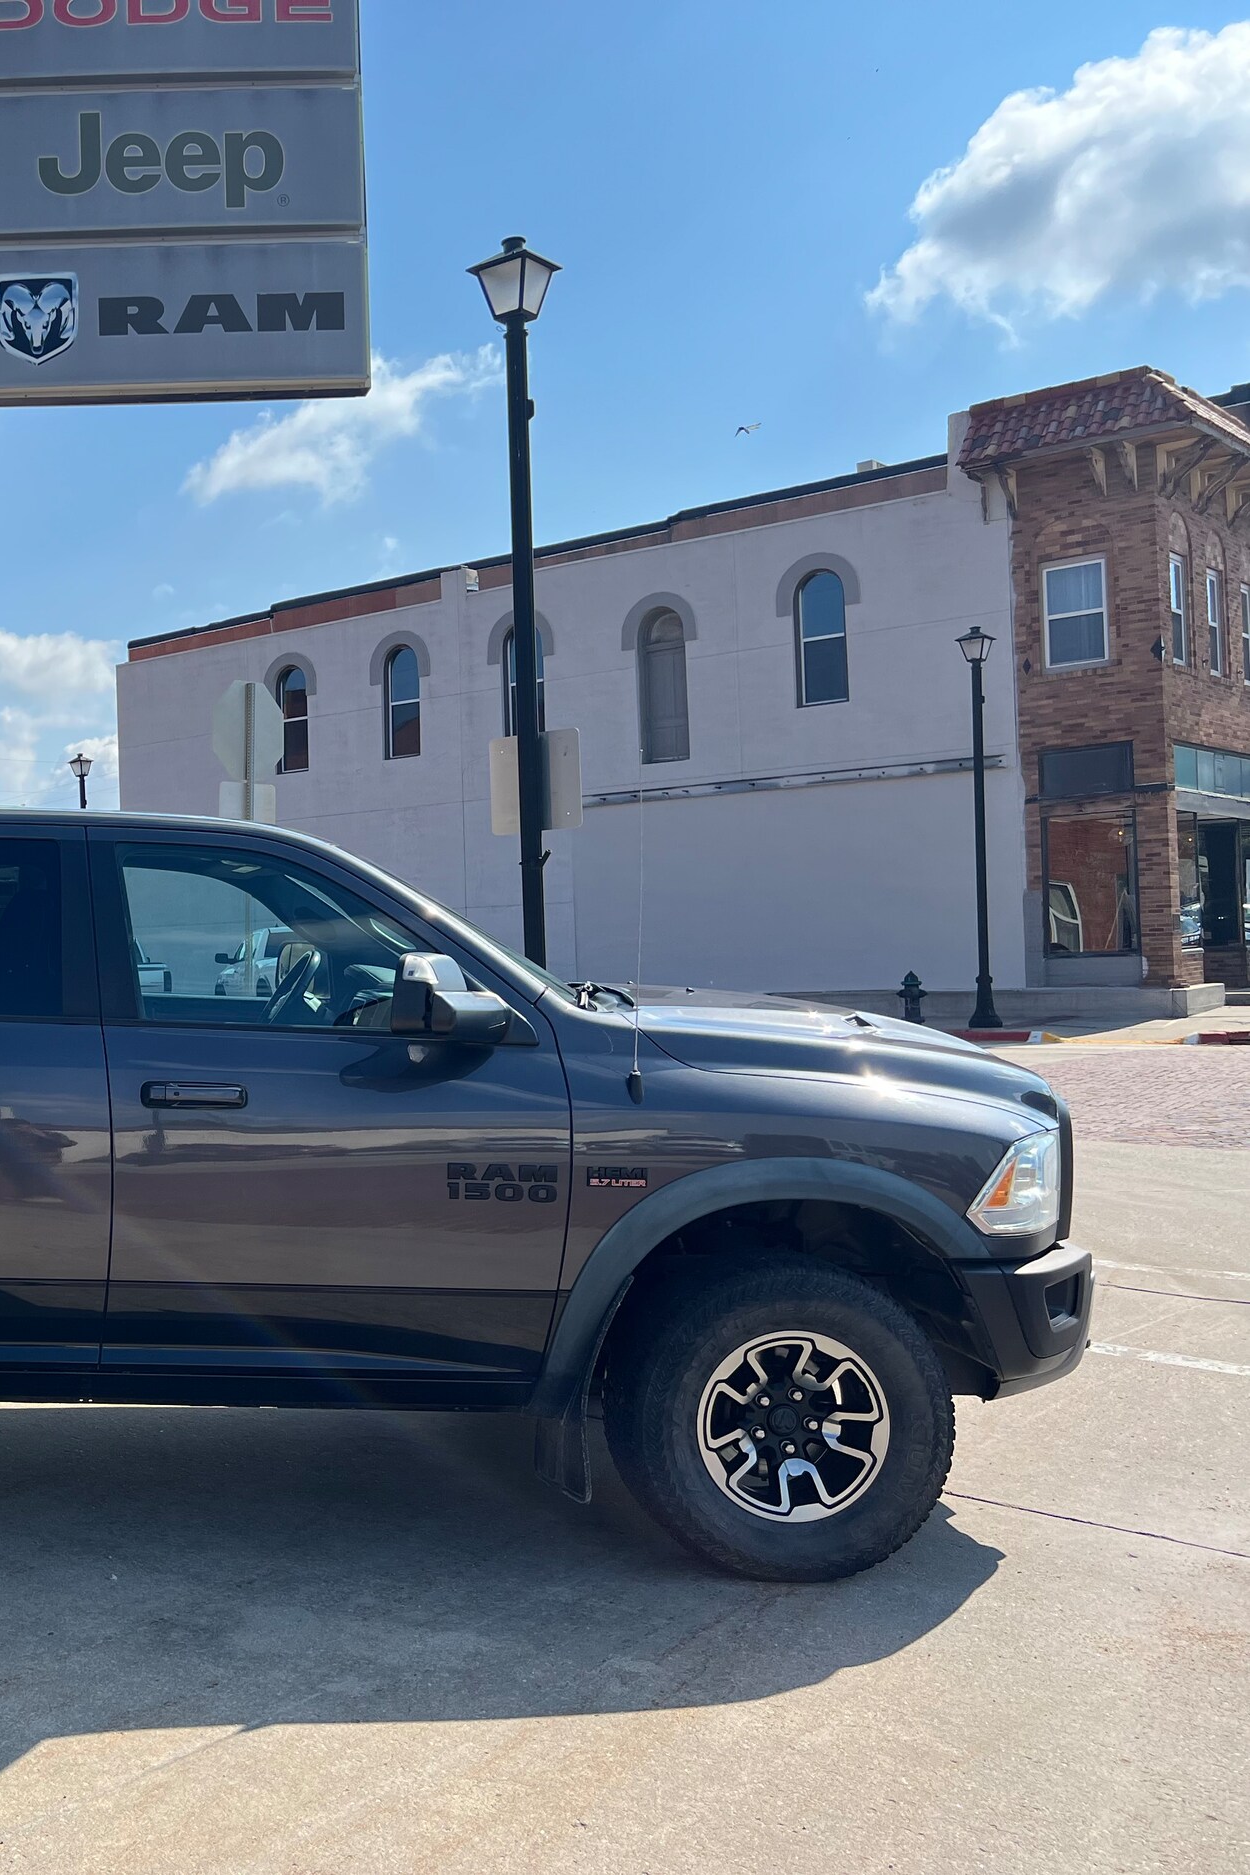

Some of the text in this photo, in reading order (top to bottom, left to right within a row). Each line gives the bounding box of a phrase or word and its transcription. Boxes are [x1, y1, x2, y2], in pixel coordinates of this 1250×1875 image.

[37, 111, 285, 208] Jeep
[98, 291, 346, 336] RAM
[446, 1162, 558, 1183] RAM
[587, 1167, 648, 1179] HEMI
[589, 1178, 647, 1187] 5.7 LITER
[446, 1182, 558, 1203] 1500
